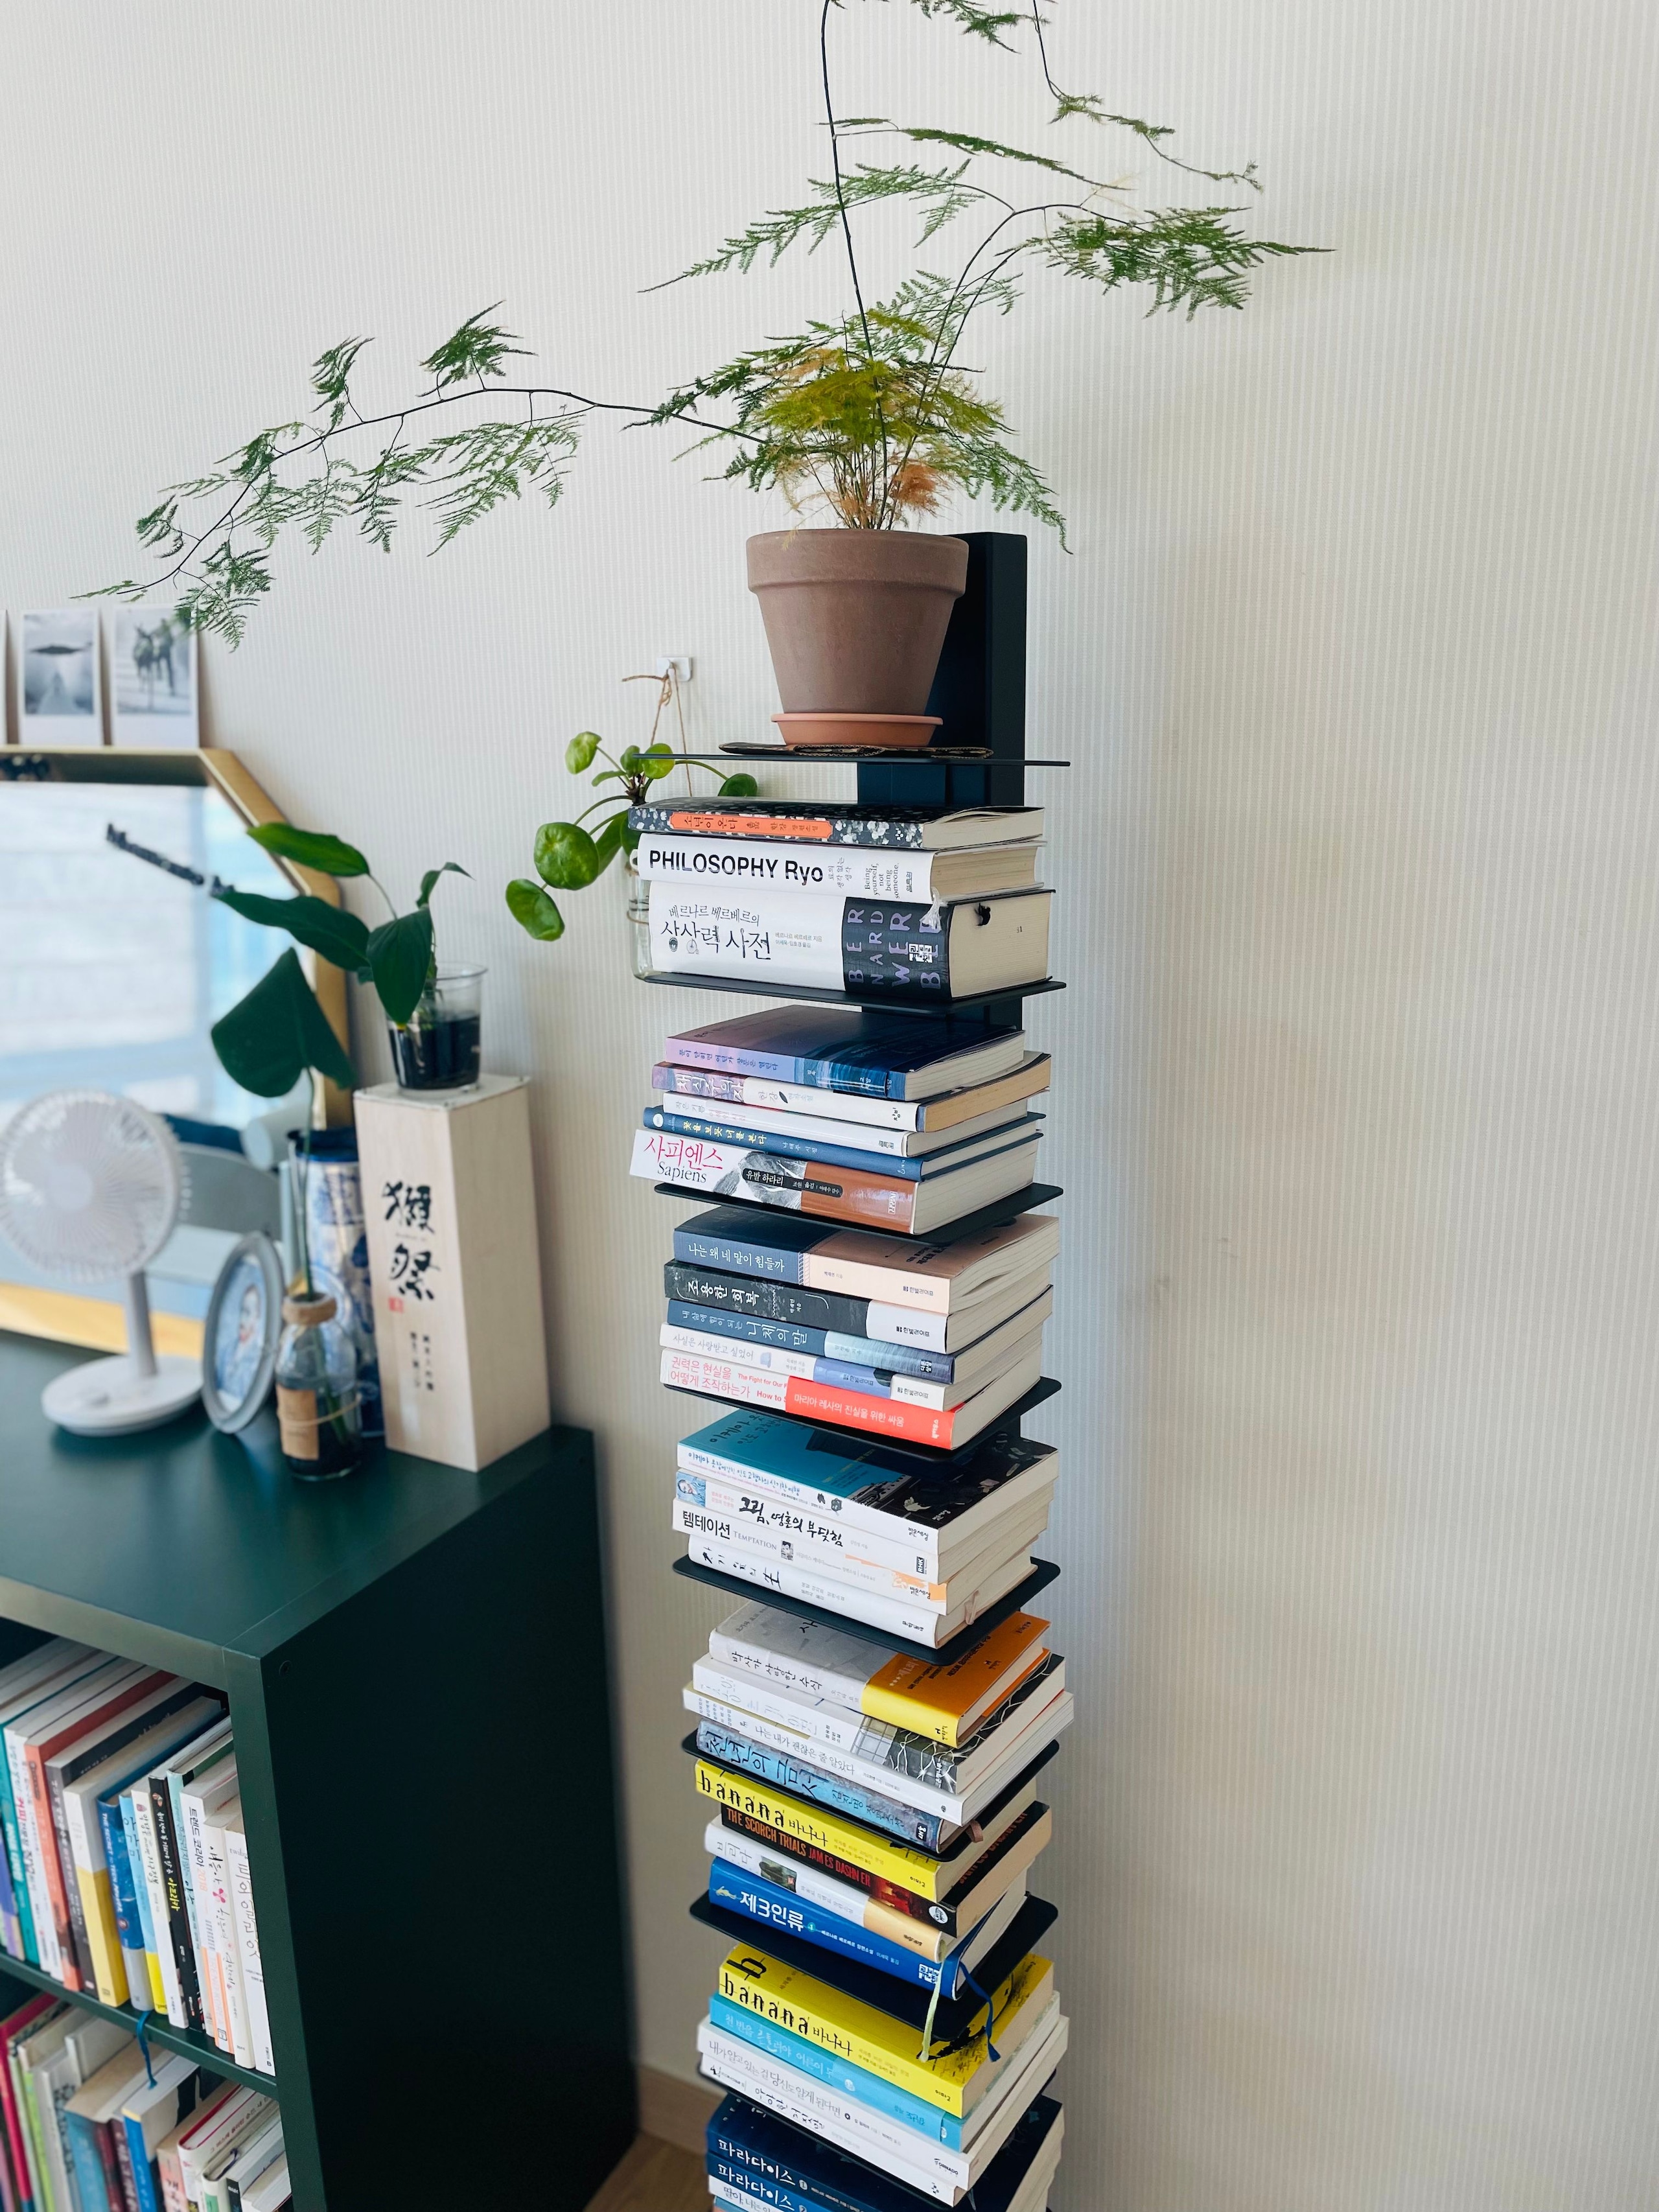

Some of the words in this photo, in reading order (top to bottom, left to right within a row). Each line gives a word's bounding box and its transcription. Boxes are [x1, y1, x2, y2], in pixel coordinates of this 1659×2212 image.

[684, 815, 713, 828] 소년이
[717, 817, 737, 829] 온다
[649, 850, 779, 878] PHILOSOPHY
[785, 859, 823, 886] Ryo
[872, 863, 880, 896] yourself,
[669, 904, 709, 918] 베르나르
[712, 906, 760, 927] 베르베르의
[725, 927, 771, 960] 사전
[869, 910, 883, 984] NARD
[889, 913, 912, 987] WER
[683, 1121, 701, 1133] 꽃을
[705, 1125, 723, 1137] 보듯
[725, 1129, 745, 1141] 너를
[748, 1134, 767, 1145] 본다
[644, 1135, 723, 1170] 사피엔스
[657, 1161, 707, 1183] Sapiens
[746, 1170, 760, 1182] 유발
[762, 1173, 783, 1186] 하라리
[689, 1243, 707, 1257] 나는
[709, 1246, 719, 1260] 왜
[721, 1249, 730, 1262] 네
[734, 1251, 752, 1266] 말이
[754, 1255, 785, 1272] 힘들까
[688, 1279, 728, 1299] 조용한
[732, 1288, 760, 1307] 회복
[682, 1310, 690, 1318] 내
[691, 1312, 708, 1322] 삶에
[710, 1316, 725, 1326] 힘이
[727, 1320, 743, 1330] 되는
[747, 1321, 789, 1342] 니체의
[792, 1329, 807, 1346] 말
[673, 1333, 696, 1347] 사실은
[698, 1340, 728, 1355] 사랑받고
[731, 1346, 754, 1360] 싶었어
[672, 1356, 701, 1373] 권력은
[703, 1362, 732, 1380] 현실을
[748, 1375, 762, 1384] Fight
[670, 1370, 699, 1386] 어떻게
[701, 1377, 750, 1399] 조작하는가
[757, 1391, 772, 1399] How
[794, 1394, 817, 1406] 마리아
[818, 1399, 842, 1413] 레사의
[844, 1406, 869, 1419] 진실을
[870, 1412, 887, 1423] 위한
[888, 1416, 905, 1428] 싸움
[688, 1452, 710, 1464] 이케아
[682, 1511, 730, 1540] 템테이션
[734, 1530, 777, 1550] TEMPTATION
[771, 1511, 803, 1533] 영혼의
[807, 1520, 843, 1547] 부딪힘
[908, 1527, 929, 1541] 밝은세상
[916, 1557, 925, 1574] RHK
[910, 1587, 931, 1600] 밝은세상
[732, 1651, 761, 1670] 박사가
[765, 1663, 796, 1681] 사랑한
[800, 1677, 822, 1691] 수식
[706, 1730, 771, 1773] 천년의
[777, 1759, 829, 1799] 금서
[755, 1726, 772, 1740] 나는
[773, 1734, 790, 1747] 내가
[793, 1741, 817, 1758] 괜찮은
[819, 1753, 828, 1764] 줄
[830, 1756, 855, 1776] 알았다
[697, 1770, 786, 1826] banana
[189, 1806, 200, 1837] 트렌드
[789, 1819, 828, 1847] 바나나
[104, 1827, 114, 1856] SECRET
[110, 1865, 119, 1884] TEEN
[194, 1837, 205, 1867] 코리아
[726, 1808, 743, 1826] THE
[745, 1817, 777, 1843] SCORCH
[778, 1832, 806, 1857] TRIALS
[809, 1848, 834, 1869] JAMES
[836, 1860, 871, 1888] DASHNER
[167, 1878, 180, 1911] 아프리카
[197, 1869, 208, 1892] 2018
[739, 1891, 804, 1932] 제3인류
[721, 1972, 809, 2035] banana
[736, 2020, 754, 2037] 번을
[796, 2053, 823, 2074] 어른이
[813, 2027, 853, 2056] 바나나
[710, 2041, 727, 2058] 내가
[728, 2050, 743, 2064] 알고
[745, 2060, 760, 2075] 있는
[760, 2067, 769, 2080] 걸
[770, 2073, 796, 2093] 당신도
[796, 2086, 815, 2104] 알게
[816, 2097, 841, 2117] 된다면
[718, 2139, 795, 2185] 파라다이스
[718, 2163, 795, 2211] 파라다이스
